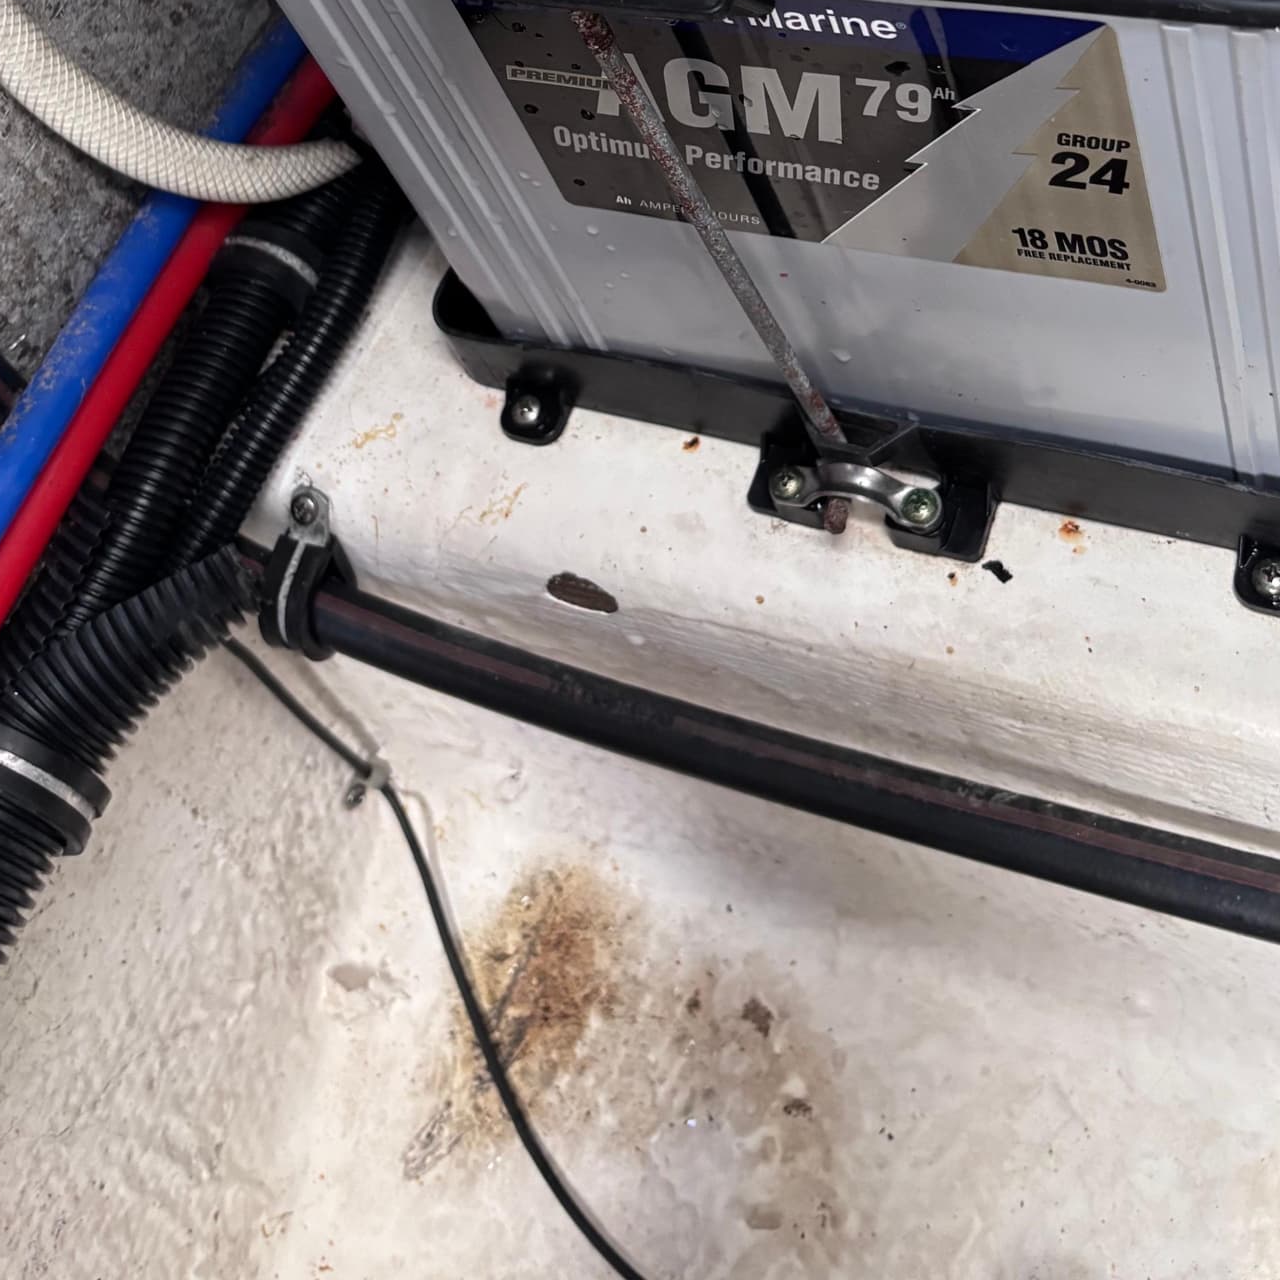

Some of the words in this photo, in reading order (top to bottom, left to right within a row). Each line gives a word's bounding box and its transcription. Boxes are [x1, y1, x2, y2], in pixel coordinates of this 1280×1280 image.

[510, 67, 612, 91] PREMIU
[855, 78, 933, 123] 79
[933, 86, 956, 101] Ah
[1057, 133, 1131, 153] GROUP
[554, 125, 652, 161] Optimu
[685, 144, 880, 191] Performance
[1048, 151, 1130, 195] 24
[616, 195, 632, 206] Ah
[1012, 227, 1049, 250] 18
[1054, 231, 1129, 261] MOS
[1017, 248, 1046, 260] FREE
[1048, 254, 1131, 271] REPLACEMENT
